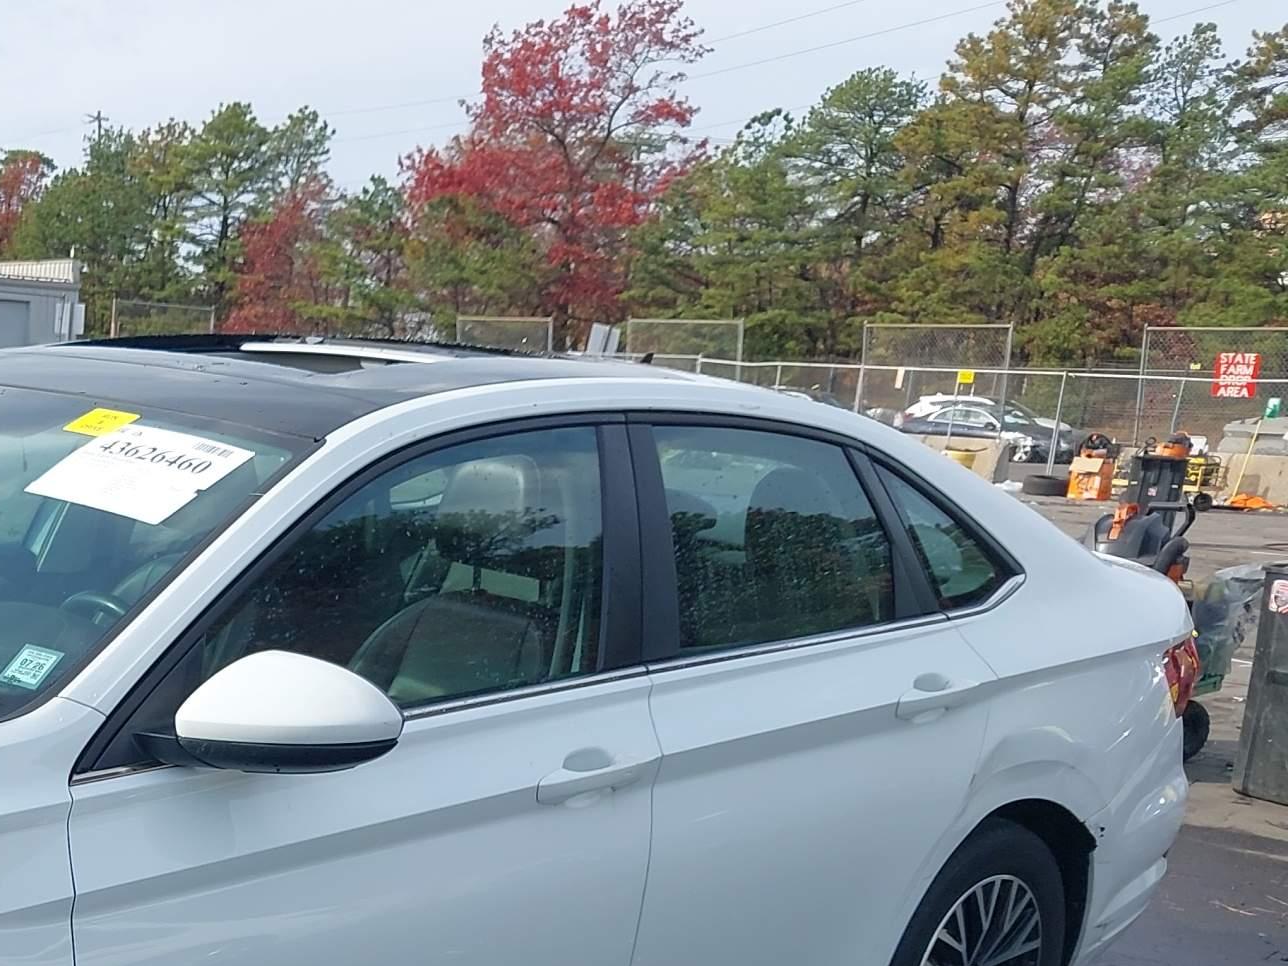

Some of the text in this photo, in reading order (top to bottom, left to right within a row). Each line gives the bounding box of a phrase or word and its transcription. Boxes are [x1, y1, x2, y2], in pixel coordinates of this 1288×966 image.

[1220, 352, 1257, 364] STATE
[1220, 364, 1254, 375] FARM
[1217, 387, 1249, 397] AREA
[100, 440, 212, 474] 43626460
